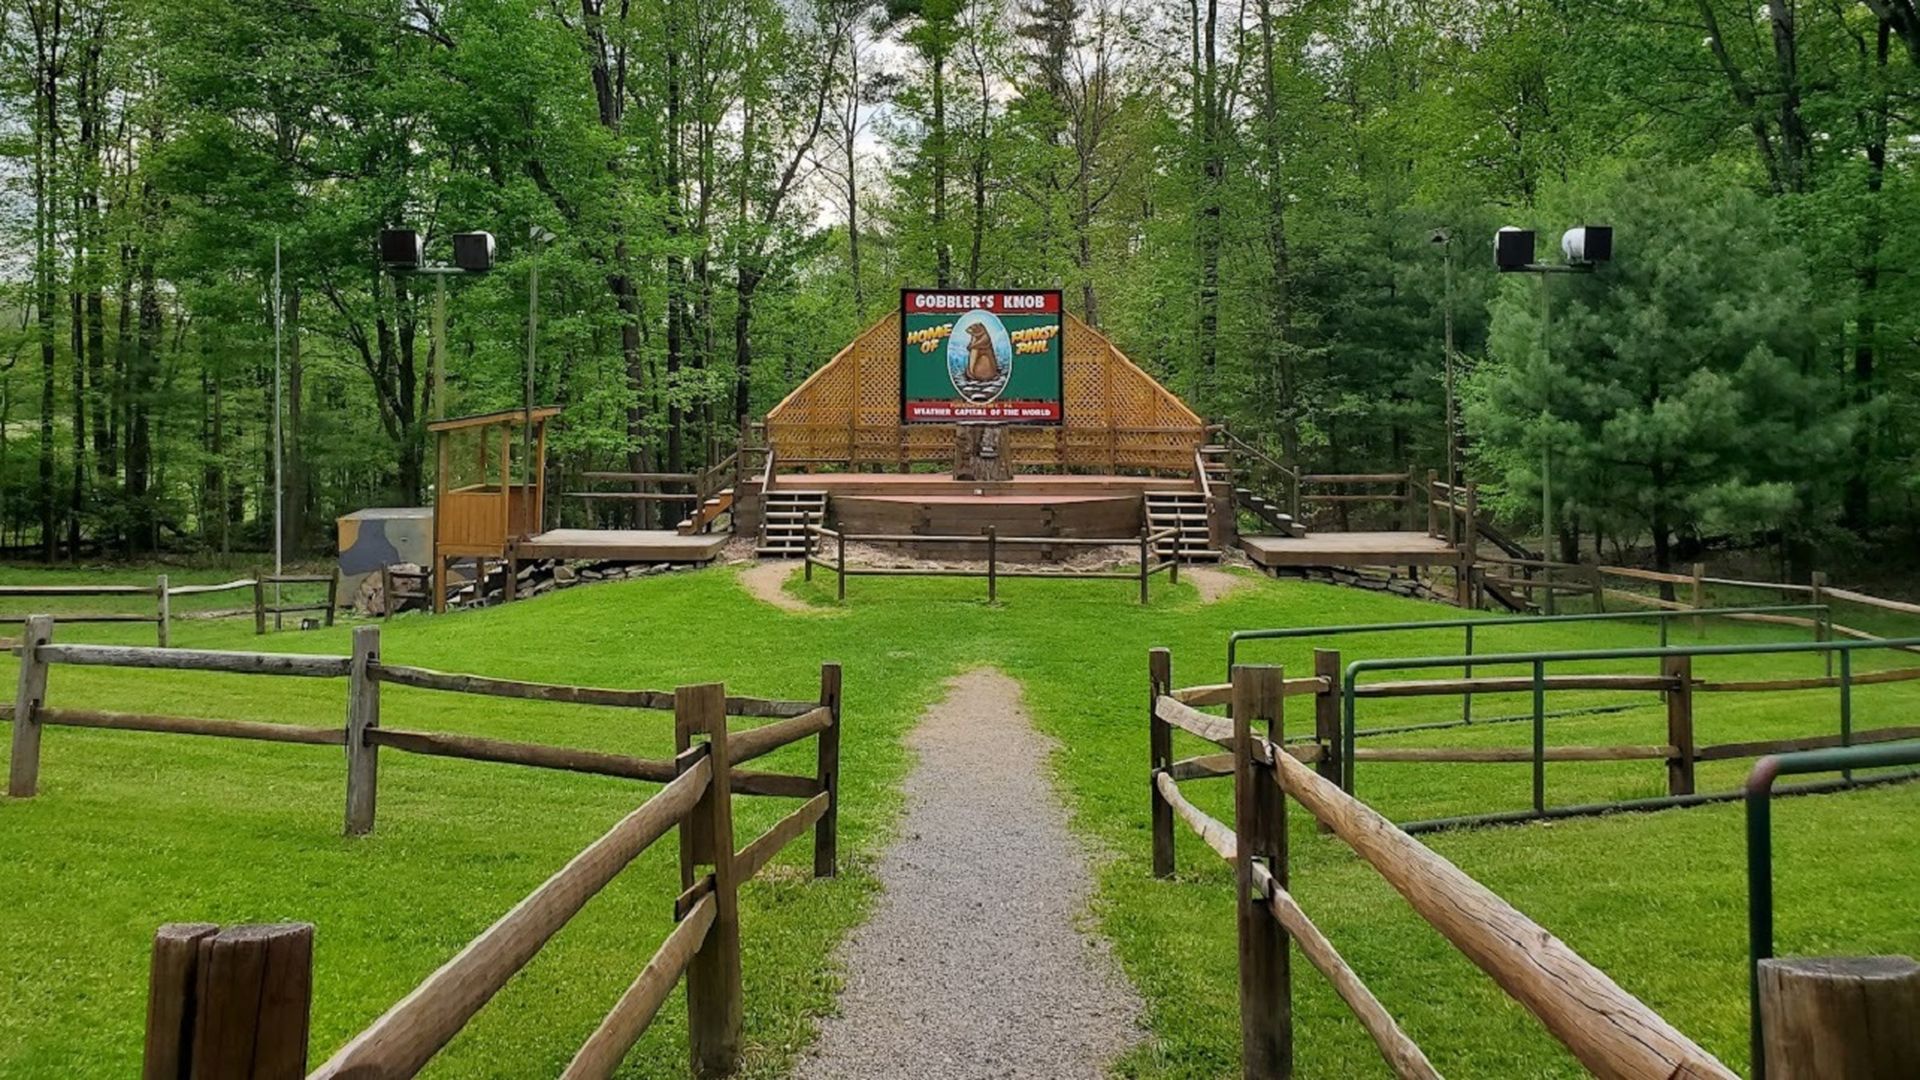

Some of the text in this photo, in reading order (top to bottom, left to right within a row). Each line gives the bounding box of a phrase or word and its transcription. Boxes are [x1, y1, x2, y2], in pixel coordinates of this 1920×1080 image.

[915, 294, 1045, 309] GOBBLER'S KNOB
[907, 323, 953, 345] HOME
[1011, 325, 1059, 344] PUNXSY
[921, 339, 940, 353] OF
[1016, 340, 1048, 355] PHIL
[913, 407, 1052, 416] WEATHER CAPITAL OF THE WORLD
